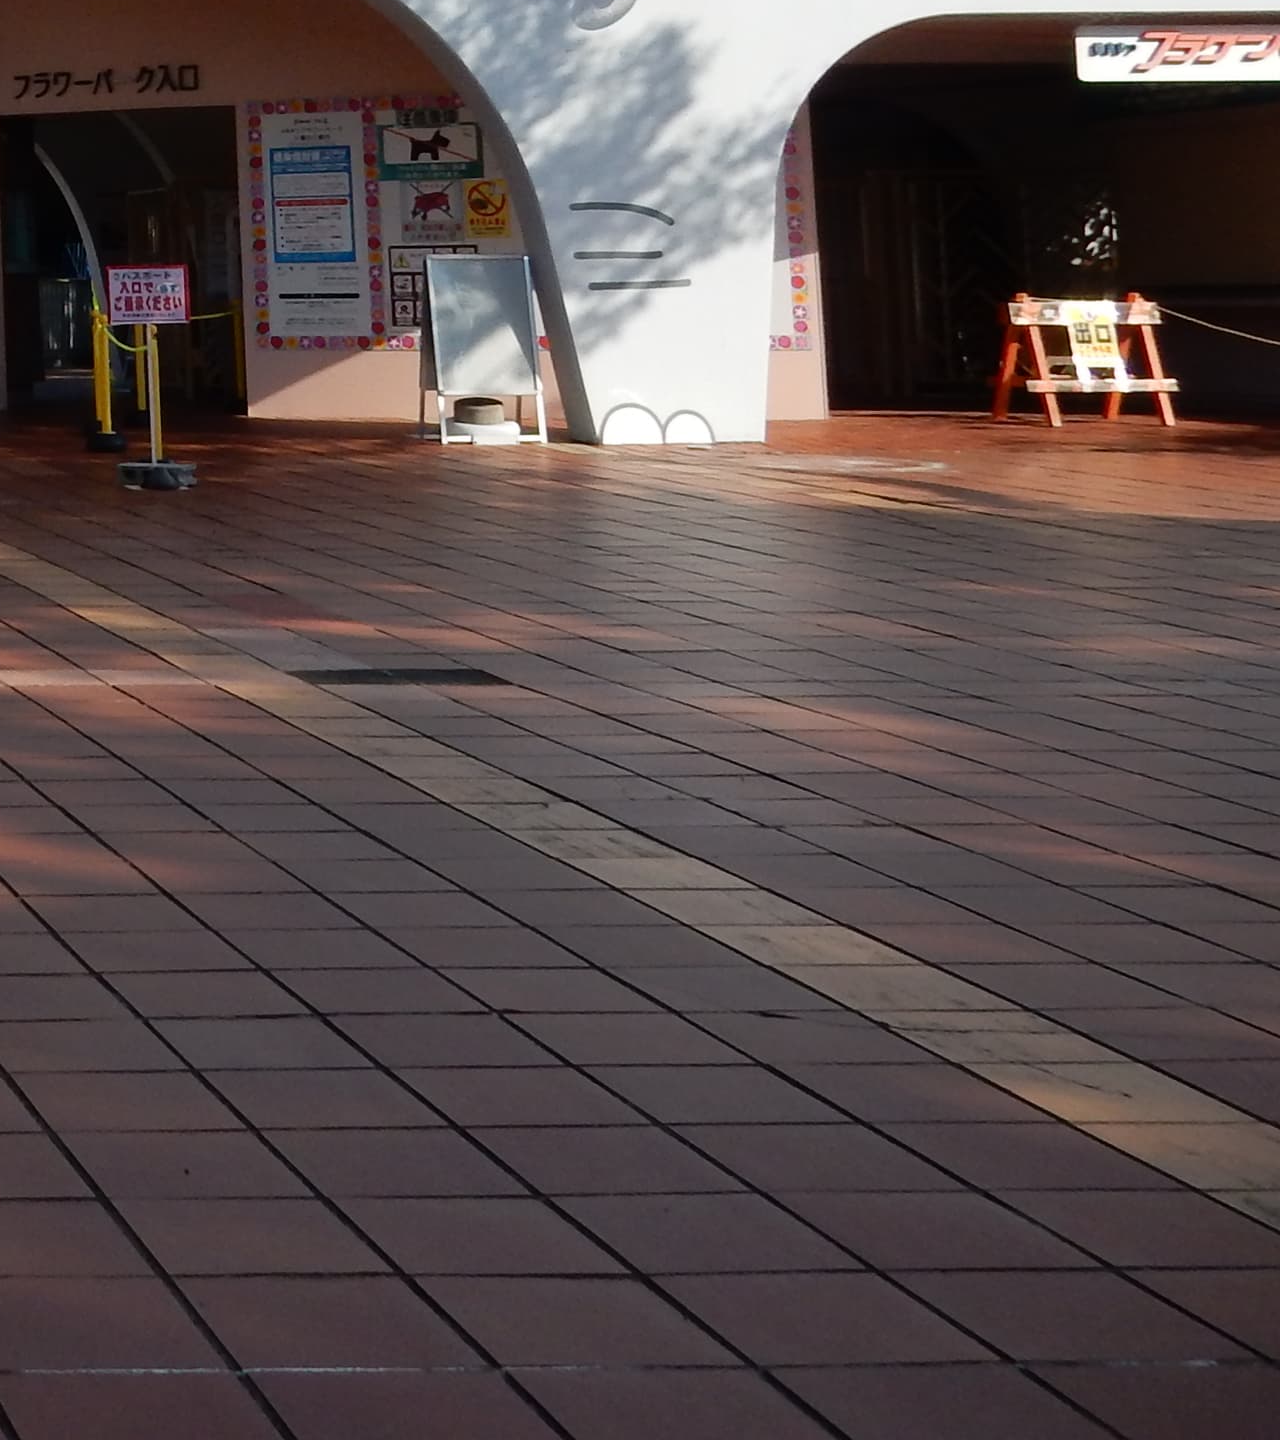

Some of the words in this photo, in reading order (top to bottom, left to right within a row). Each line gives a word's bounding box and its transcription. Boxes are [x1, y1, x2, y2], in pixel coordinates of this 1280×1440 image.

[13, 64, 200, 100] フラワーパク入口
